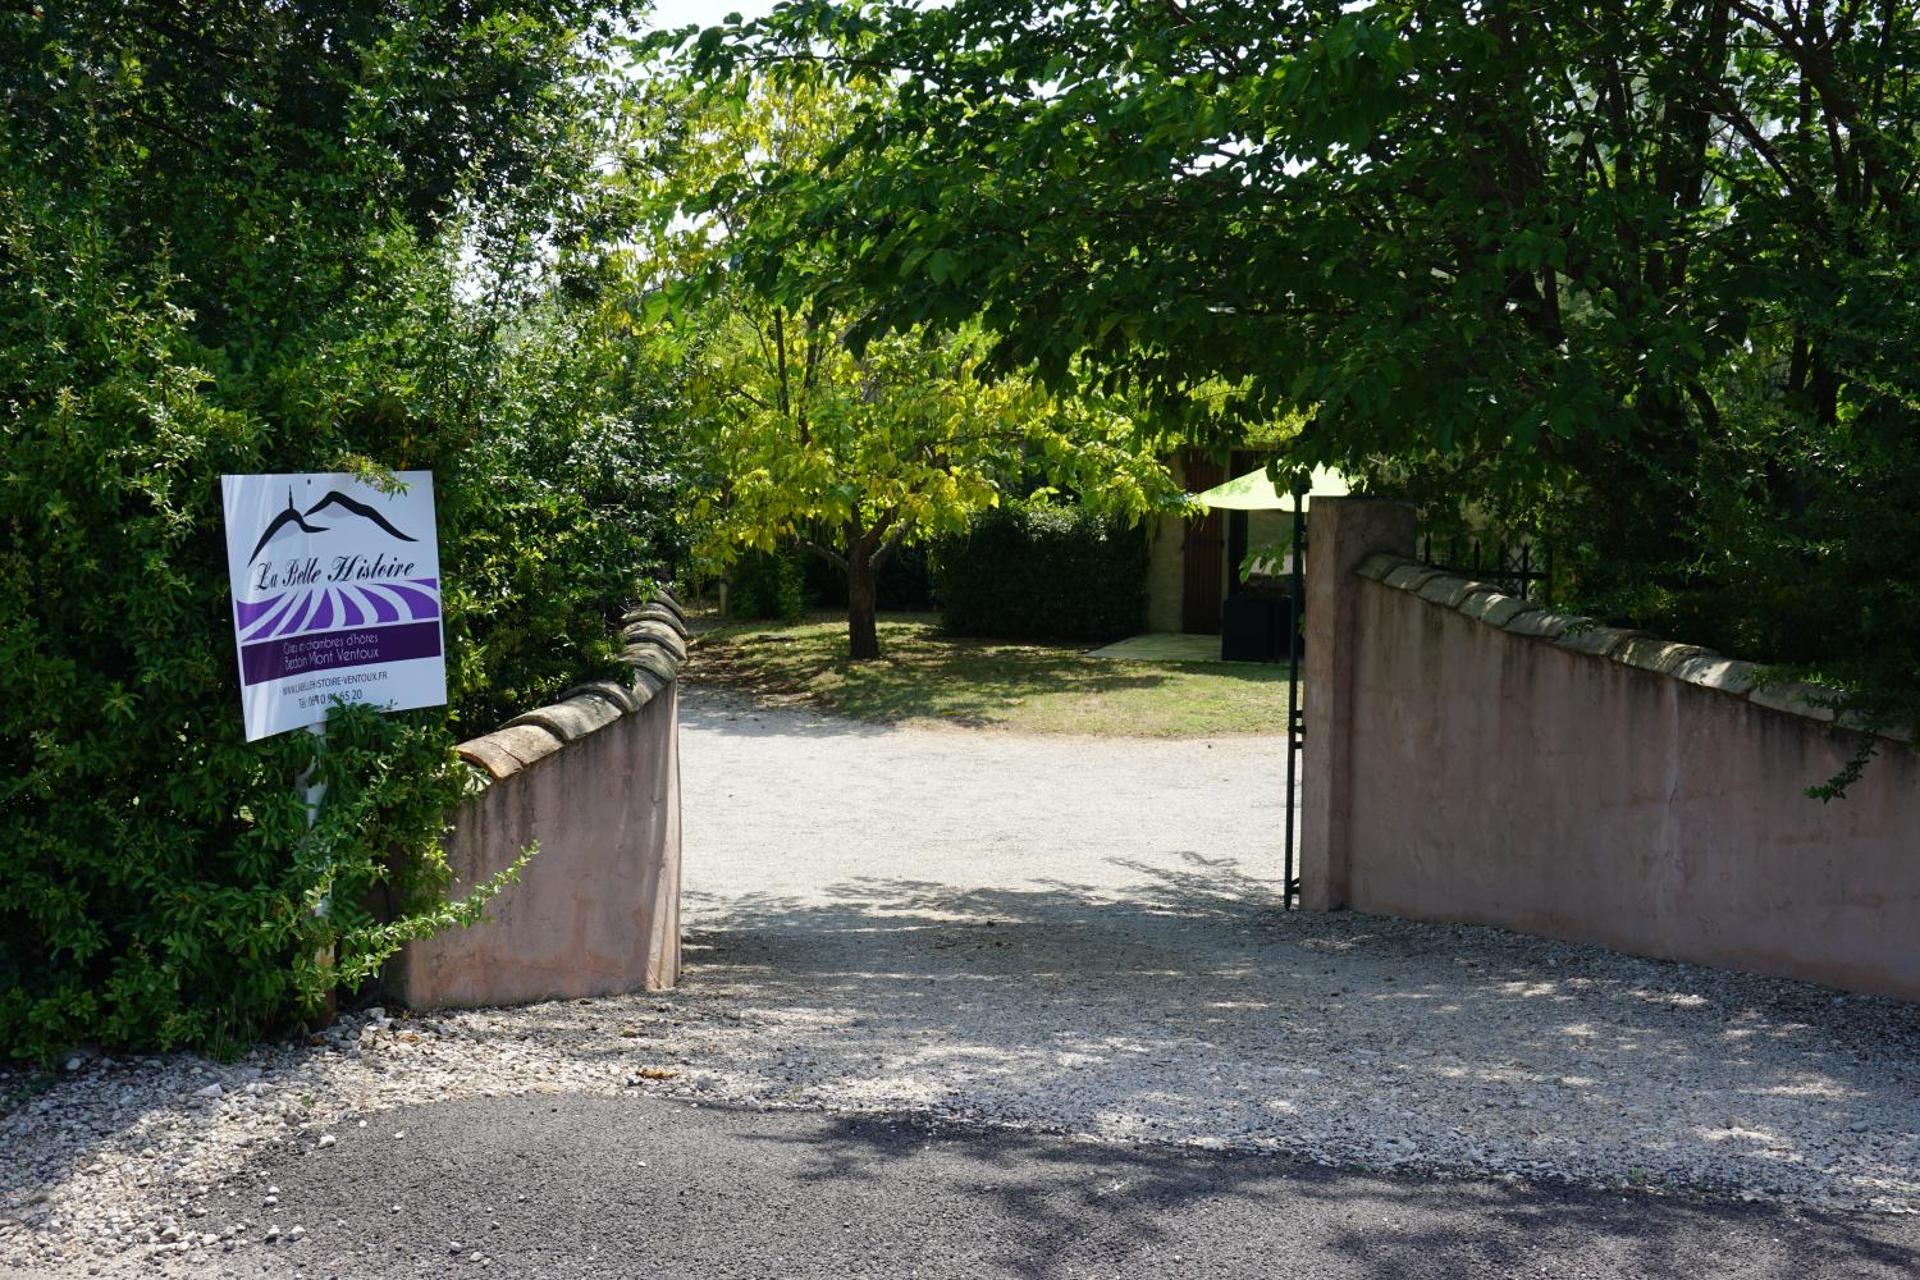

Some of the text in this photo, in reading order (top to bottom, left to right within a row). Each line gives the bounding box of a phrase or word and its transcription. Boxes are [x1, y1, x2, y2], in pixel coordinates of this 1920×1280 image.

[255, 552, 415, 591] La Belle Histoire
[309, 650, 333, 666] Mont
[336, 647, 379, 661] Ventoux
